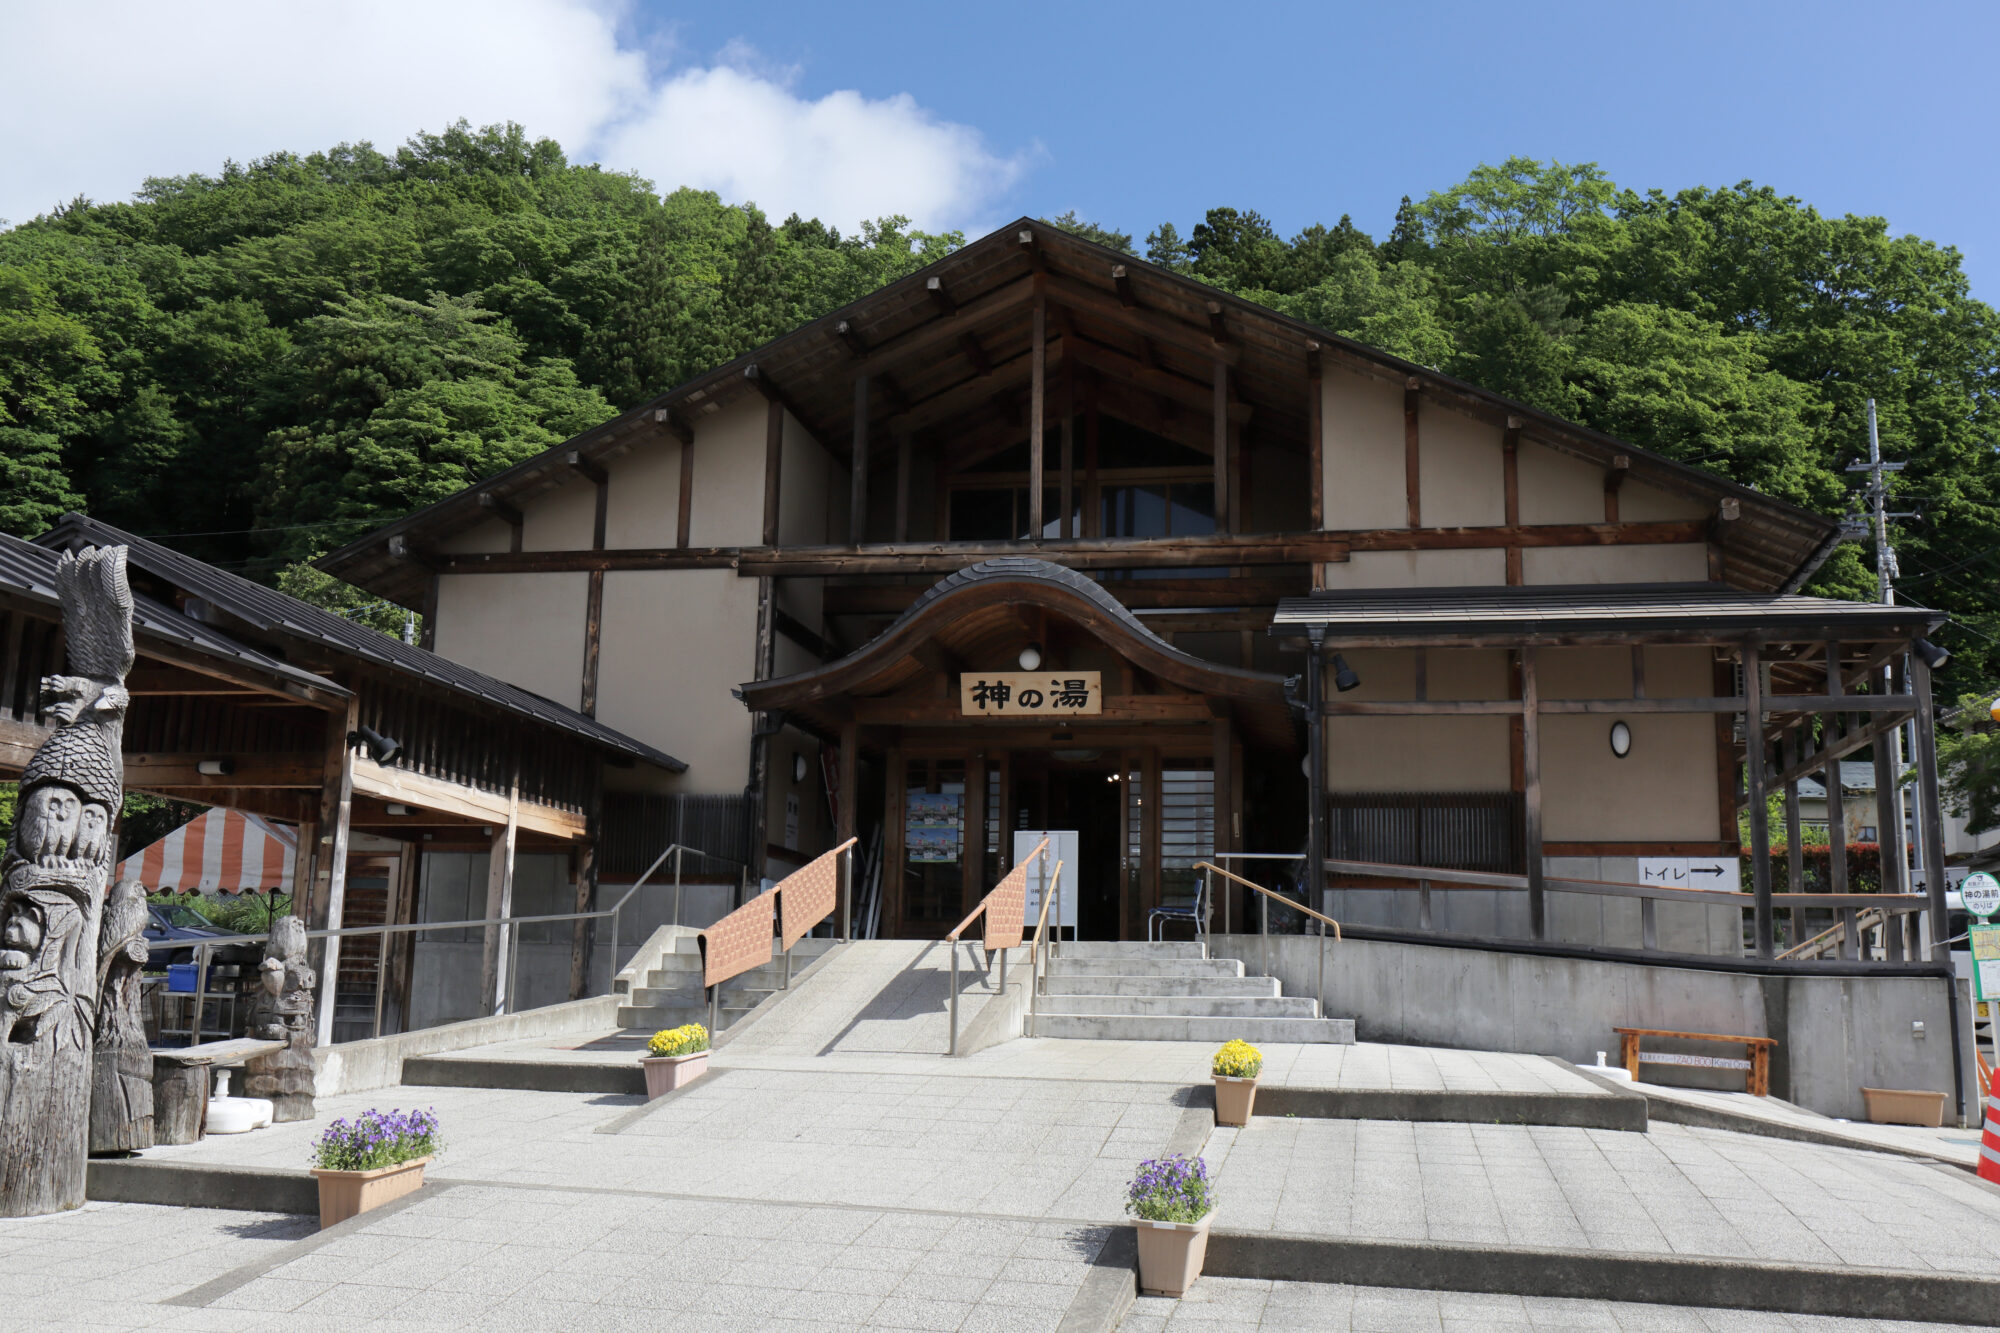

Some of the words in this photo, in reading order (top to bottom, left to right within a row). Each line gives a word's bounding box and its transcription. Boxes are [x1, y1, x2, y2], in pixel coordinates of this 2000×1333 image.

[972, 680, 1090, 710] 神の湯
[1644, 866, 1686, 881] トイレ
[1964, 889, 1999, 900] 神の湯前
